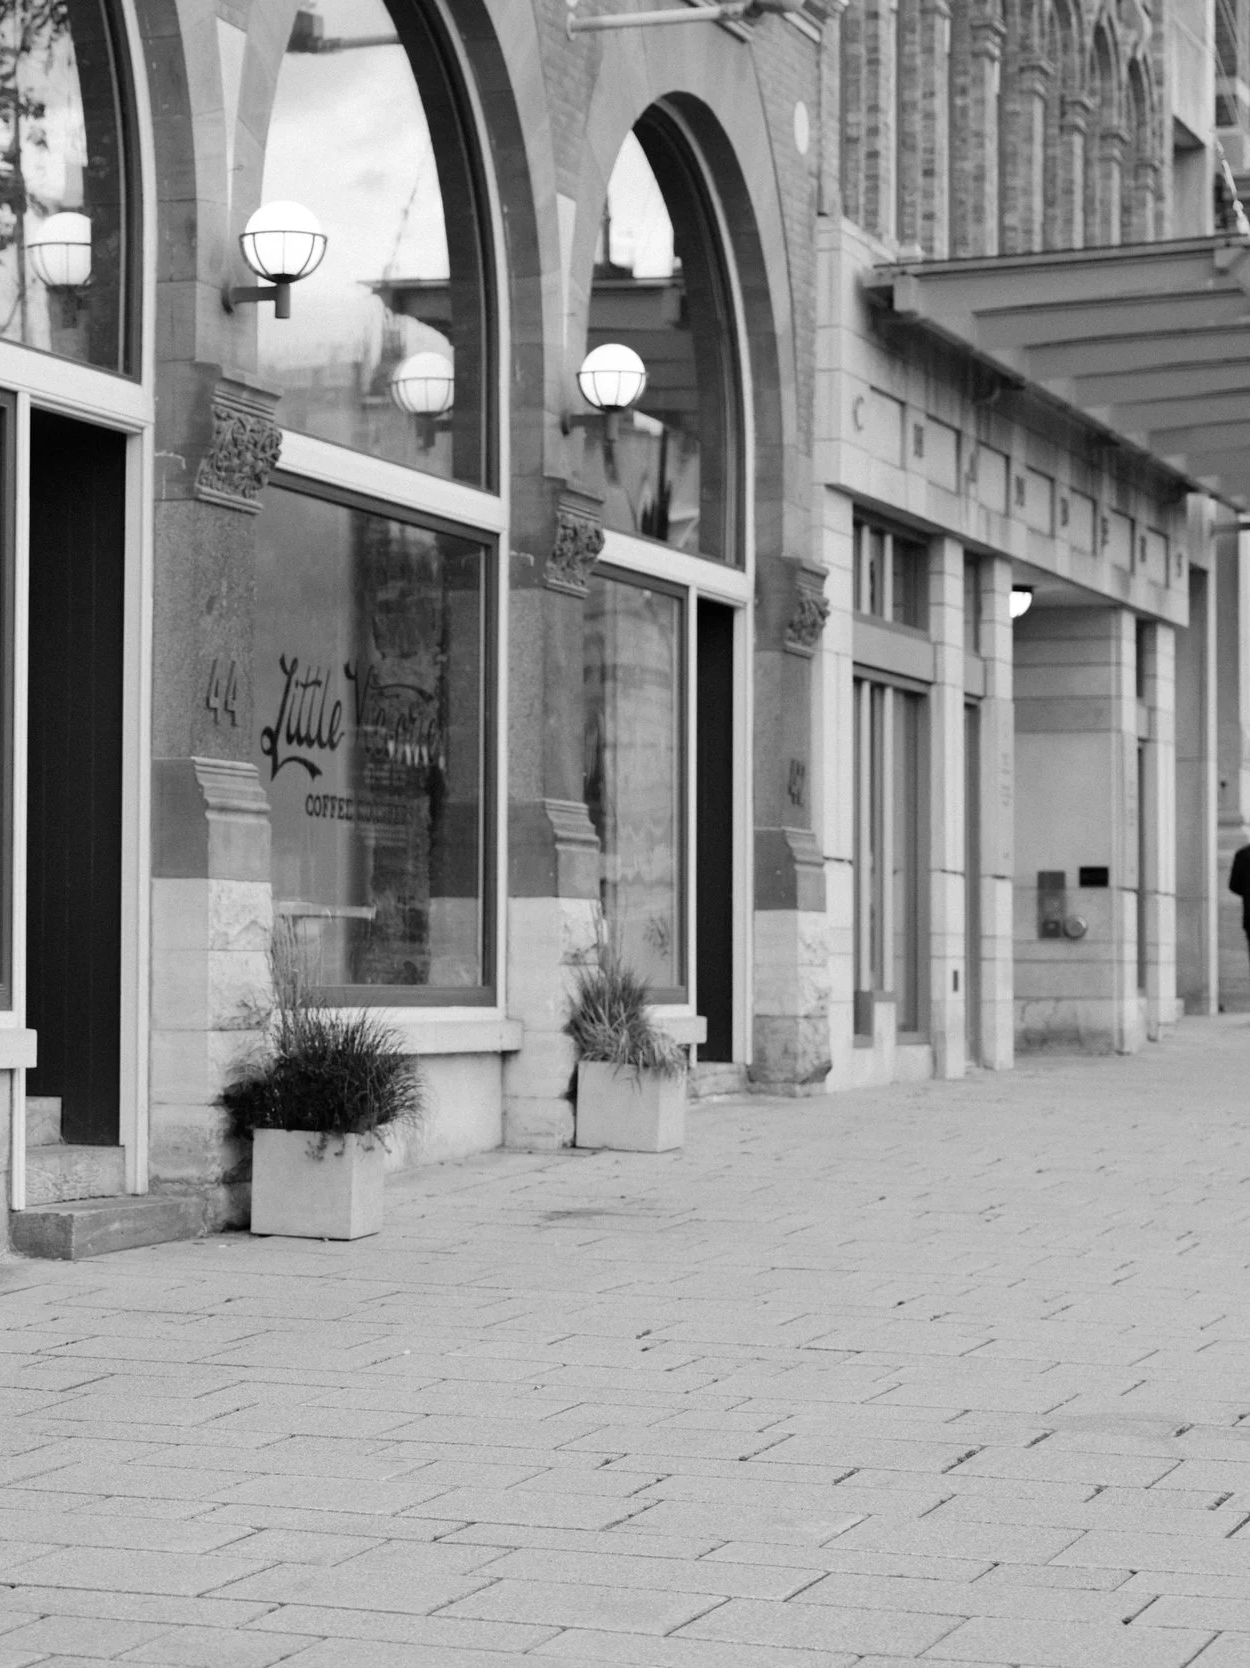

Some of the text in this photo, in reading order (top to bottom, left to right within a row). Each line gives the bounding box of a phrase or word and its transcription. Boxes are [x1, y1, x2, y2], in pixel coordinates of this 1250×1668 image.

[205, 656, 238, 727] 44
[260, 652, 345, 781] Little
[305, 793, 354, 821] COFFEE
